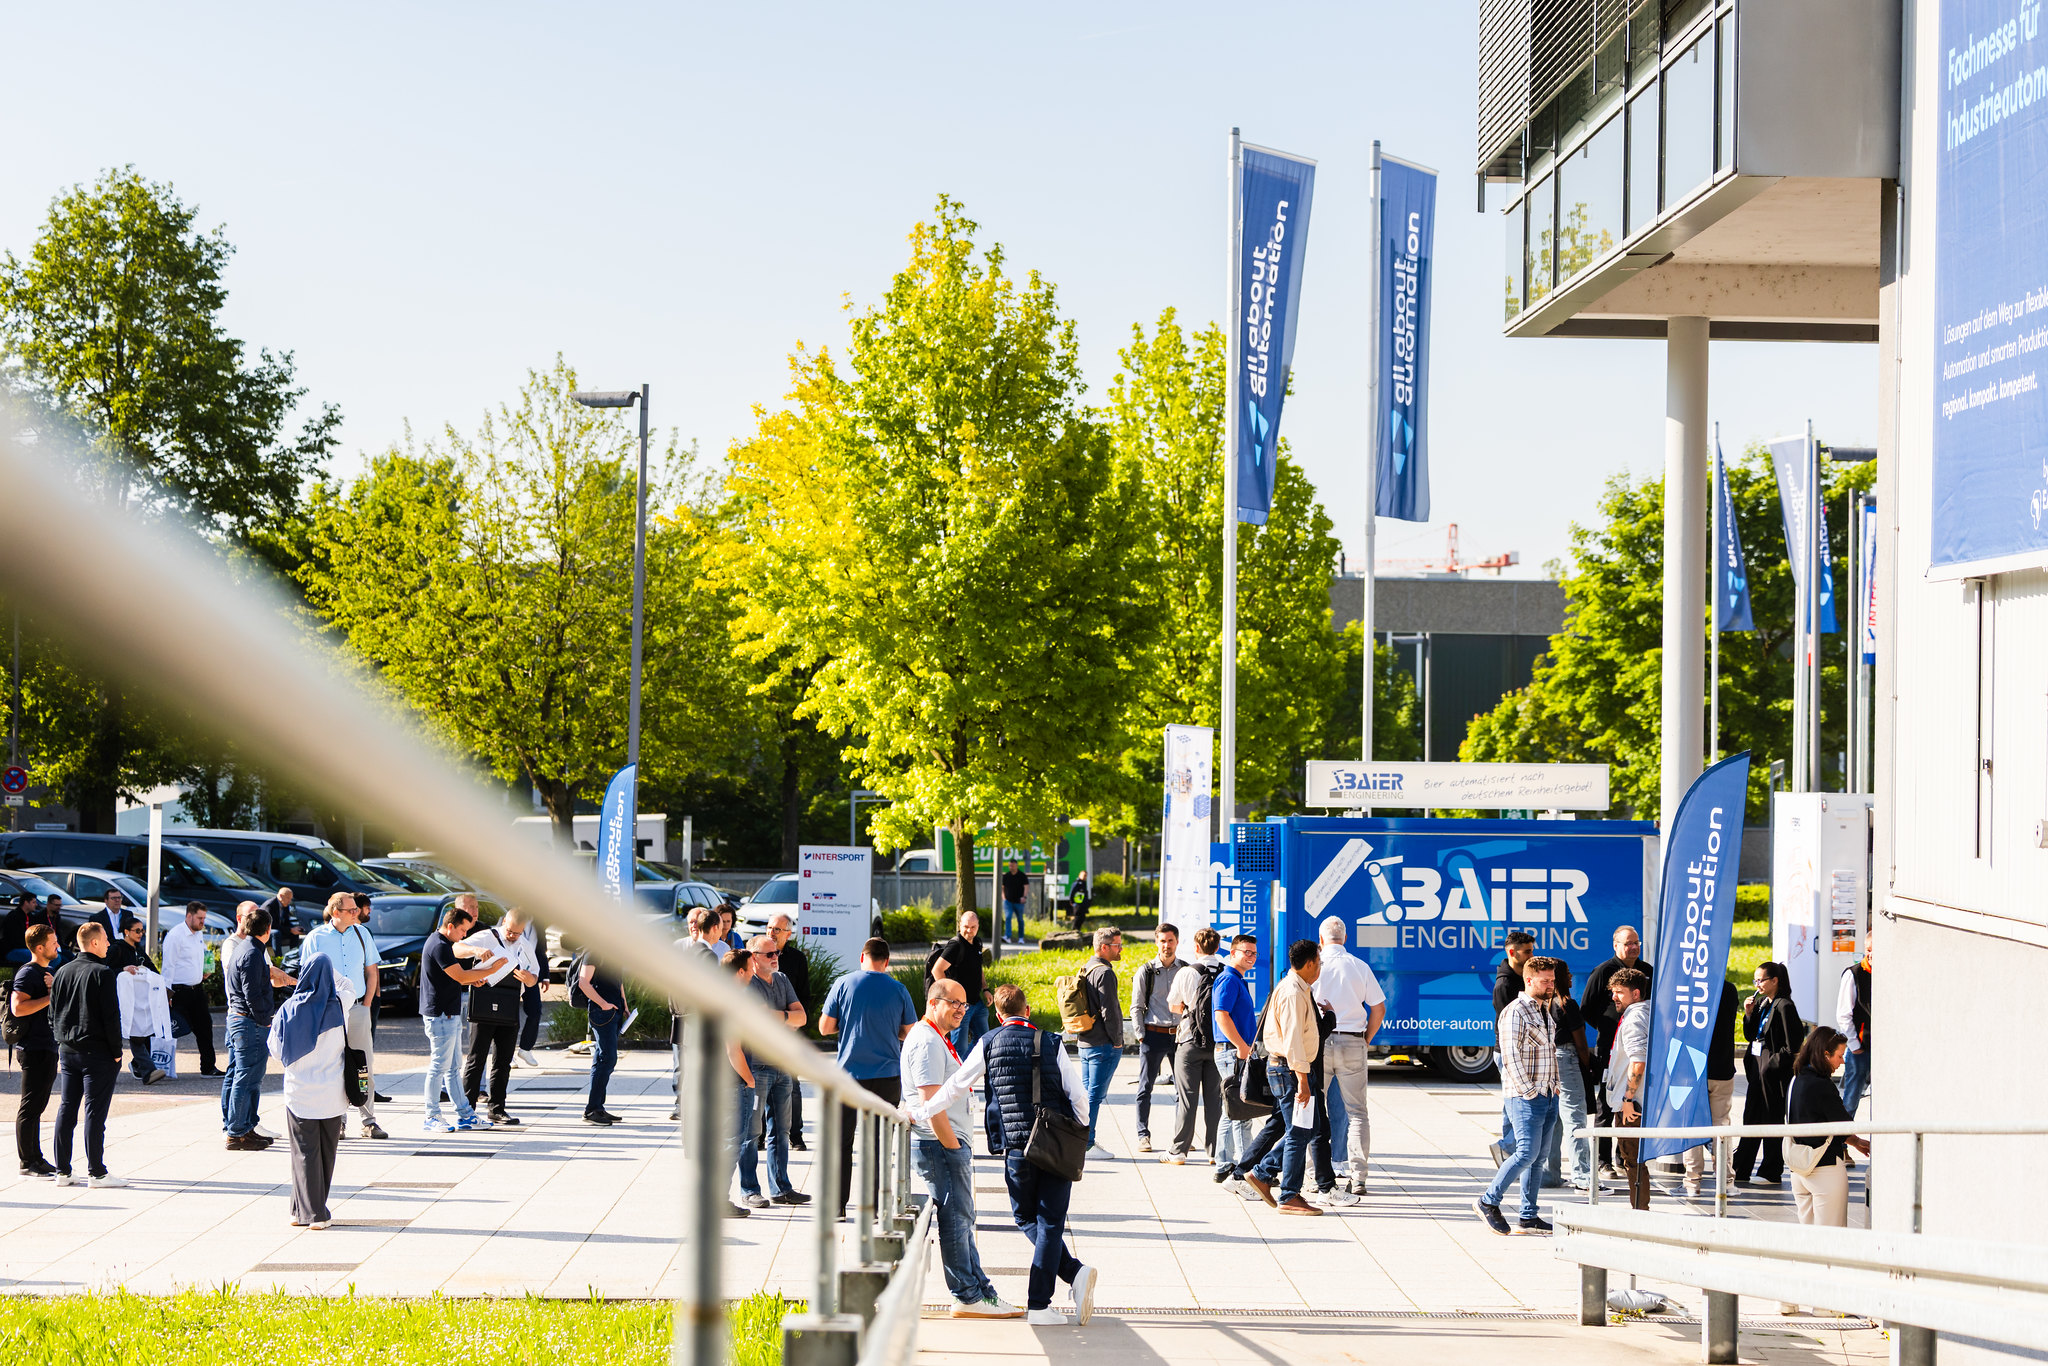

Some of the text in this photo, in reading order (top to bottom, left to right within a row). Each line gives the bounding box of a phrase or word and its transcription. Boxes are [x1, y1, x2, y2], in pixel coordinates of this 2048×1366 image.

[1948, 0, 2041, 91] Fachmesse für
[1947, 64, 2048, 151] Industrieautom
[1247, 246, 1268, 395] all about
[1257, 200, 1289, 397] automation
[1405, 212, 1420, 406] automation
[1944, 320, 1972, 345] Lösungen
[1972, 309, 1984, 334] auf
[1984, 307, 1998, 330] dem
[1998, 301, 2014, 325] Weg
[2014, 300, 2025, 319] zur
[1393, 257, 1407, 403] all about
[1942, 351, 1977, 381] Automation
[1978, 343, 1990, 369] und
[1991, 340, 2017, 364] smarten
[1942, 388, 1969, 420] regional.
[1999, 370, 2038, 401] kompetent.
[1343, 791, 1404, 800] ENGINEERING
[1424, 770, 1545, 790] Bier automatisiert nach
[1461, 789, 1514, 801] deutschem
[606, 818, 616, 881] about
[812, 853, 865, 861] INTERSPORT
[1402, 925, 1589, 951] ENGINERING
[1676, 861, 1703, 1028] all about
[1692, 807, 1723, 1029] automation
[1381, 1017, 1493, 1030] w.roboter-autom
